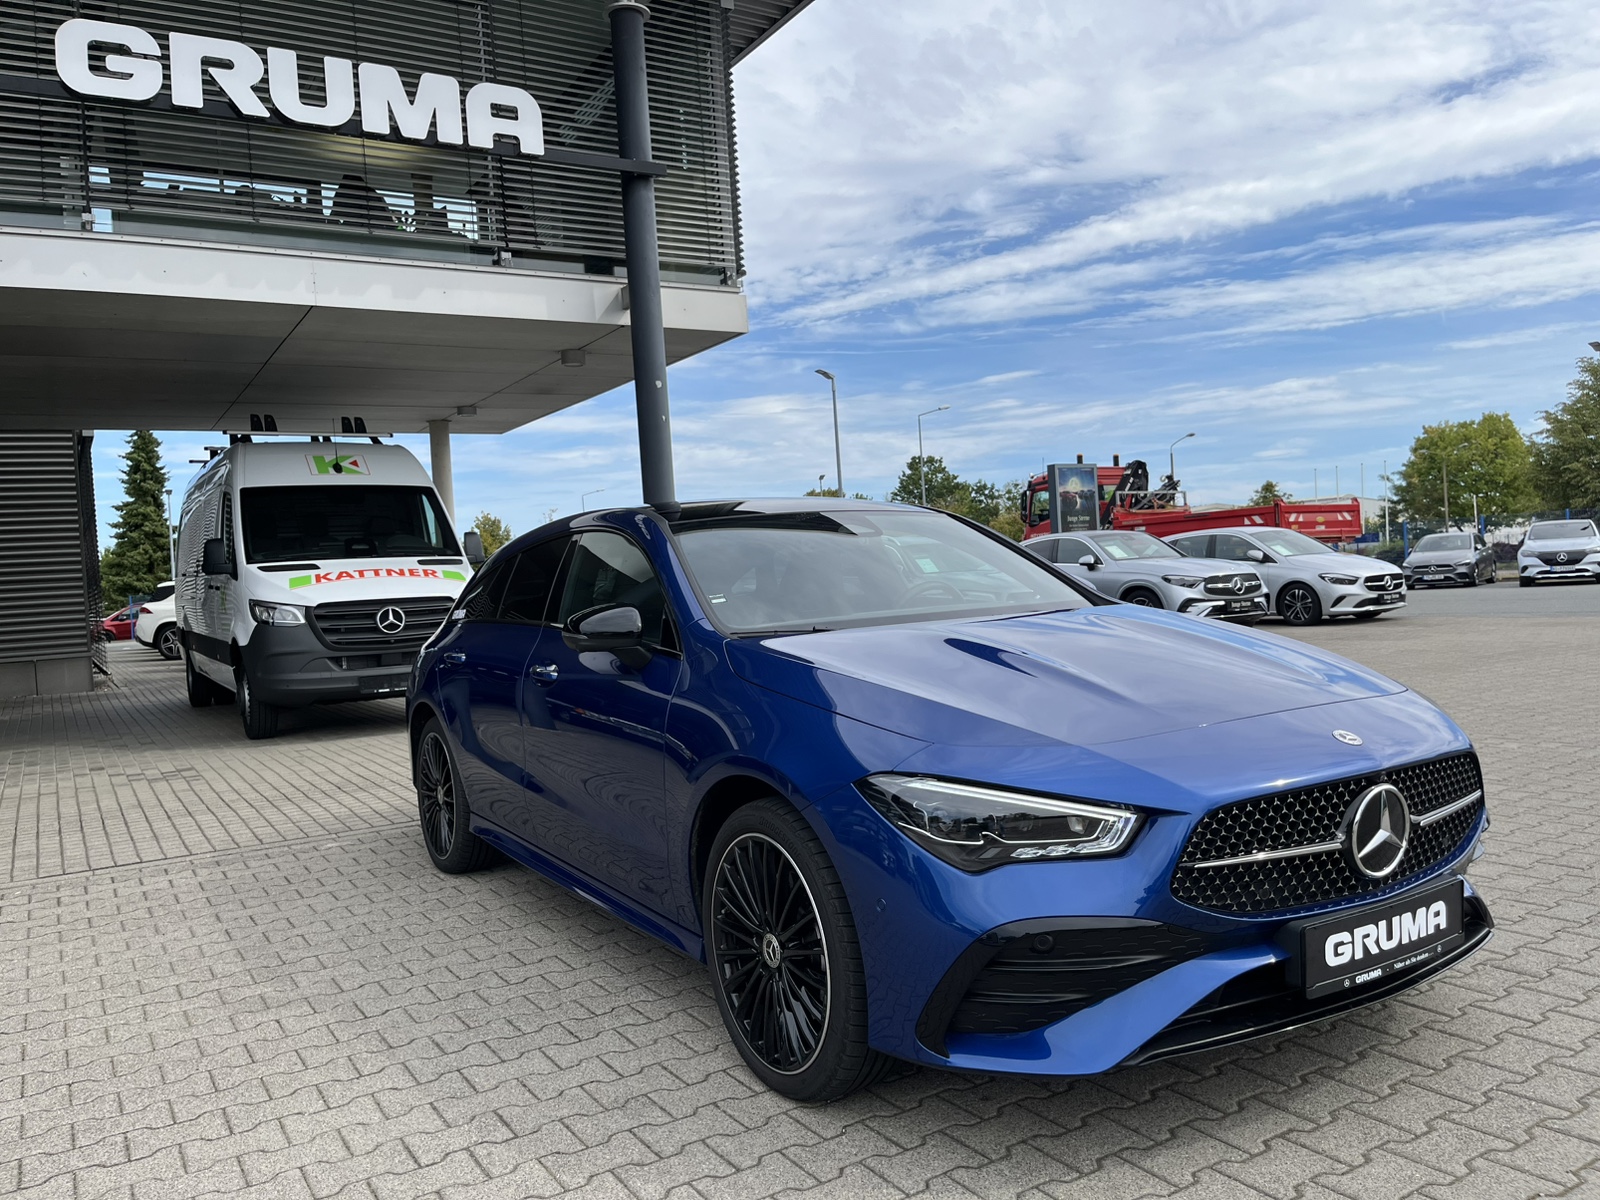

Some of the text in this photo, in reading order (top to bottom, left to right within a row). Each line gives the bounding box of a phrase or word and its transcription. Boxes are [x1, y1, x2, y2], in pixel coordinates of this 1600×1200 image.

[55, 18, 545, 156] GRUMA
[1067, 515, 1078, 523] Junge
[315, 568, 440, 584] KATTNER
[758, 816, 802, 859] BRIDGESTONE
[1324, 900, 1447, 968] GRUMA
[1355, 968, 1382, 984] GRUMA
